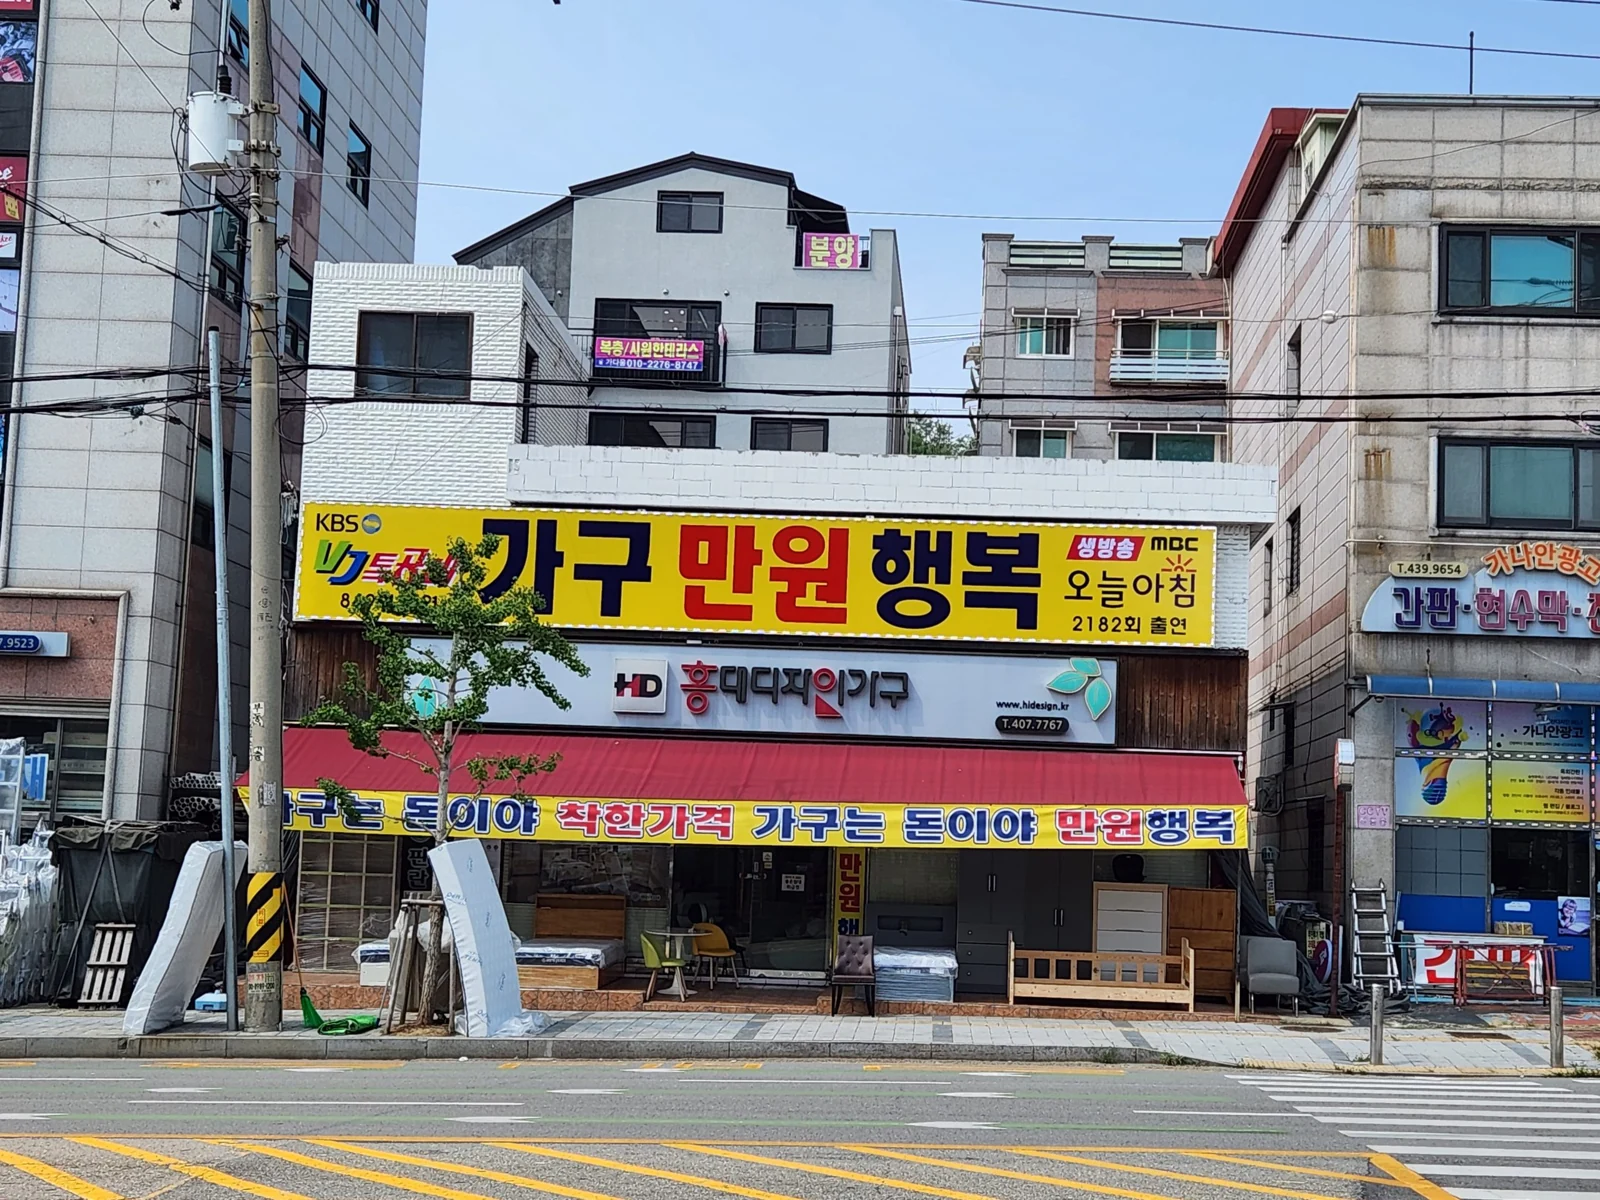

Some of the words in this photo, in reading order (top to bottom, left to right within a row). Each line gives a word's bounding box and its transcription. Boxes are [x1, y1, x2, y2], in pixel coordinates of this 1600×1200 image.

[809, 235, 855, 268] 분양
[626, 359, 698, 370] 010-2276-8747
[316, 513, 359, 532] KBS
[1077, 537, 1135, 559] 생방송
[1151, 536, 1199, 552] MBC
[483, 518, 652, 617] 가구
[679, 525, 849, 624] 만원
[872, 528, 1041, 630] 행복
[1397, 563, 1461, 575] T.439.9654
[1072, 616, 1141, 634] 2182회
[1150, 616, 1187, 636] 출연
[614, 673, 662, 697] HD
[681, 660, 909, 718] 홍대디자인가구
[996, 700, 1069, 711] www.hidesign.kr
[1002, 718, 1063, 730] T.407.7767
[1522, 724, 1585, 739] 가나안광고
[404, 794, 541, 835] 돈이야
[557, 800, 736, 841] 착한가격
[753, 805, 885, 843] 가구는
[903, 807, 1039, 845] 돈이야
